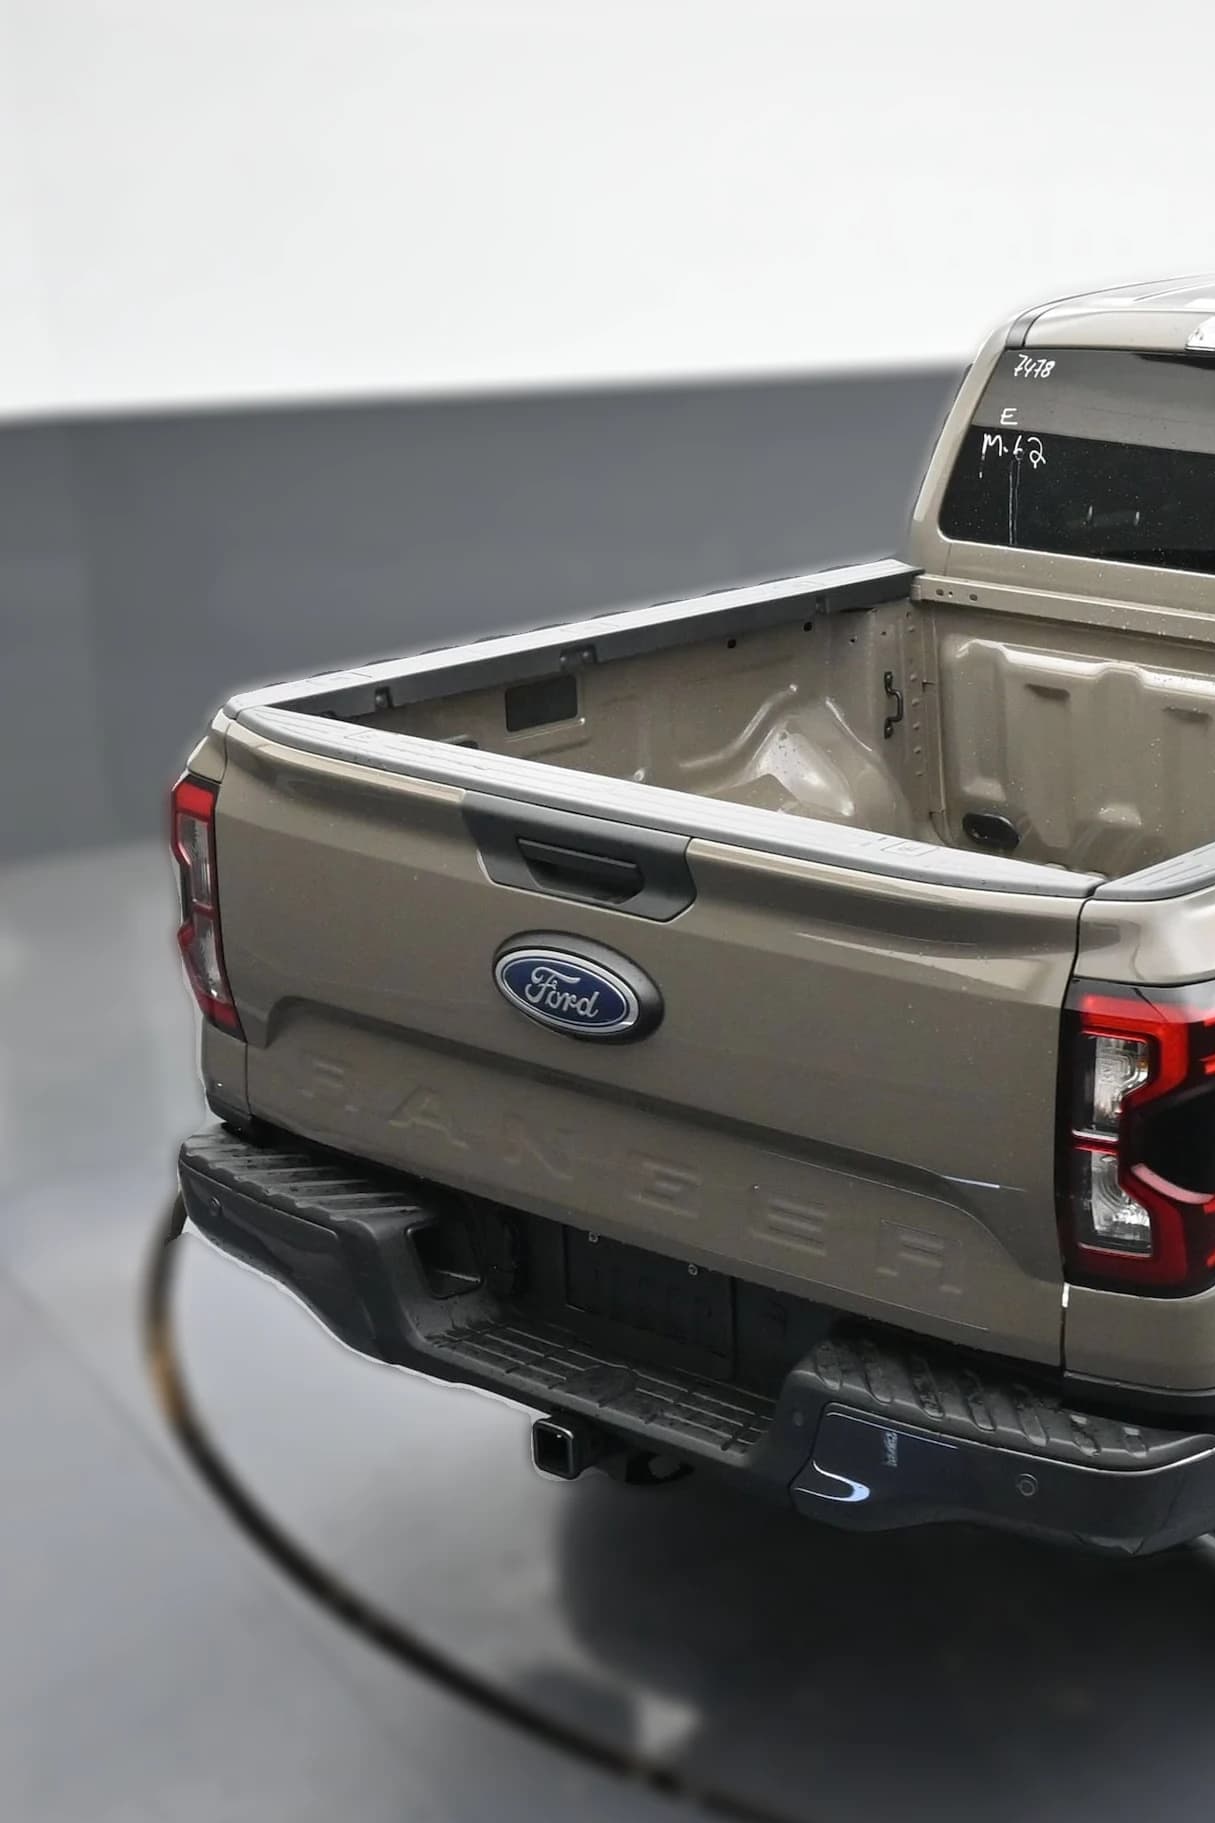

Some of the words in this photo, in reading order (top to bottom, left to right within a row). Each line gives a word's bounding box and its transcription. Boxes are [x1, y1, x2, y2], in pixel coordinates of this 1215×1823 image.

[1014, 354, 1056, 378] 7478
[1000, 407, 1018, 425] E
[524, 966, 600, 1018] Ford
[297, 1053, 964, 1294] RANGER
